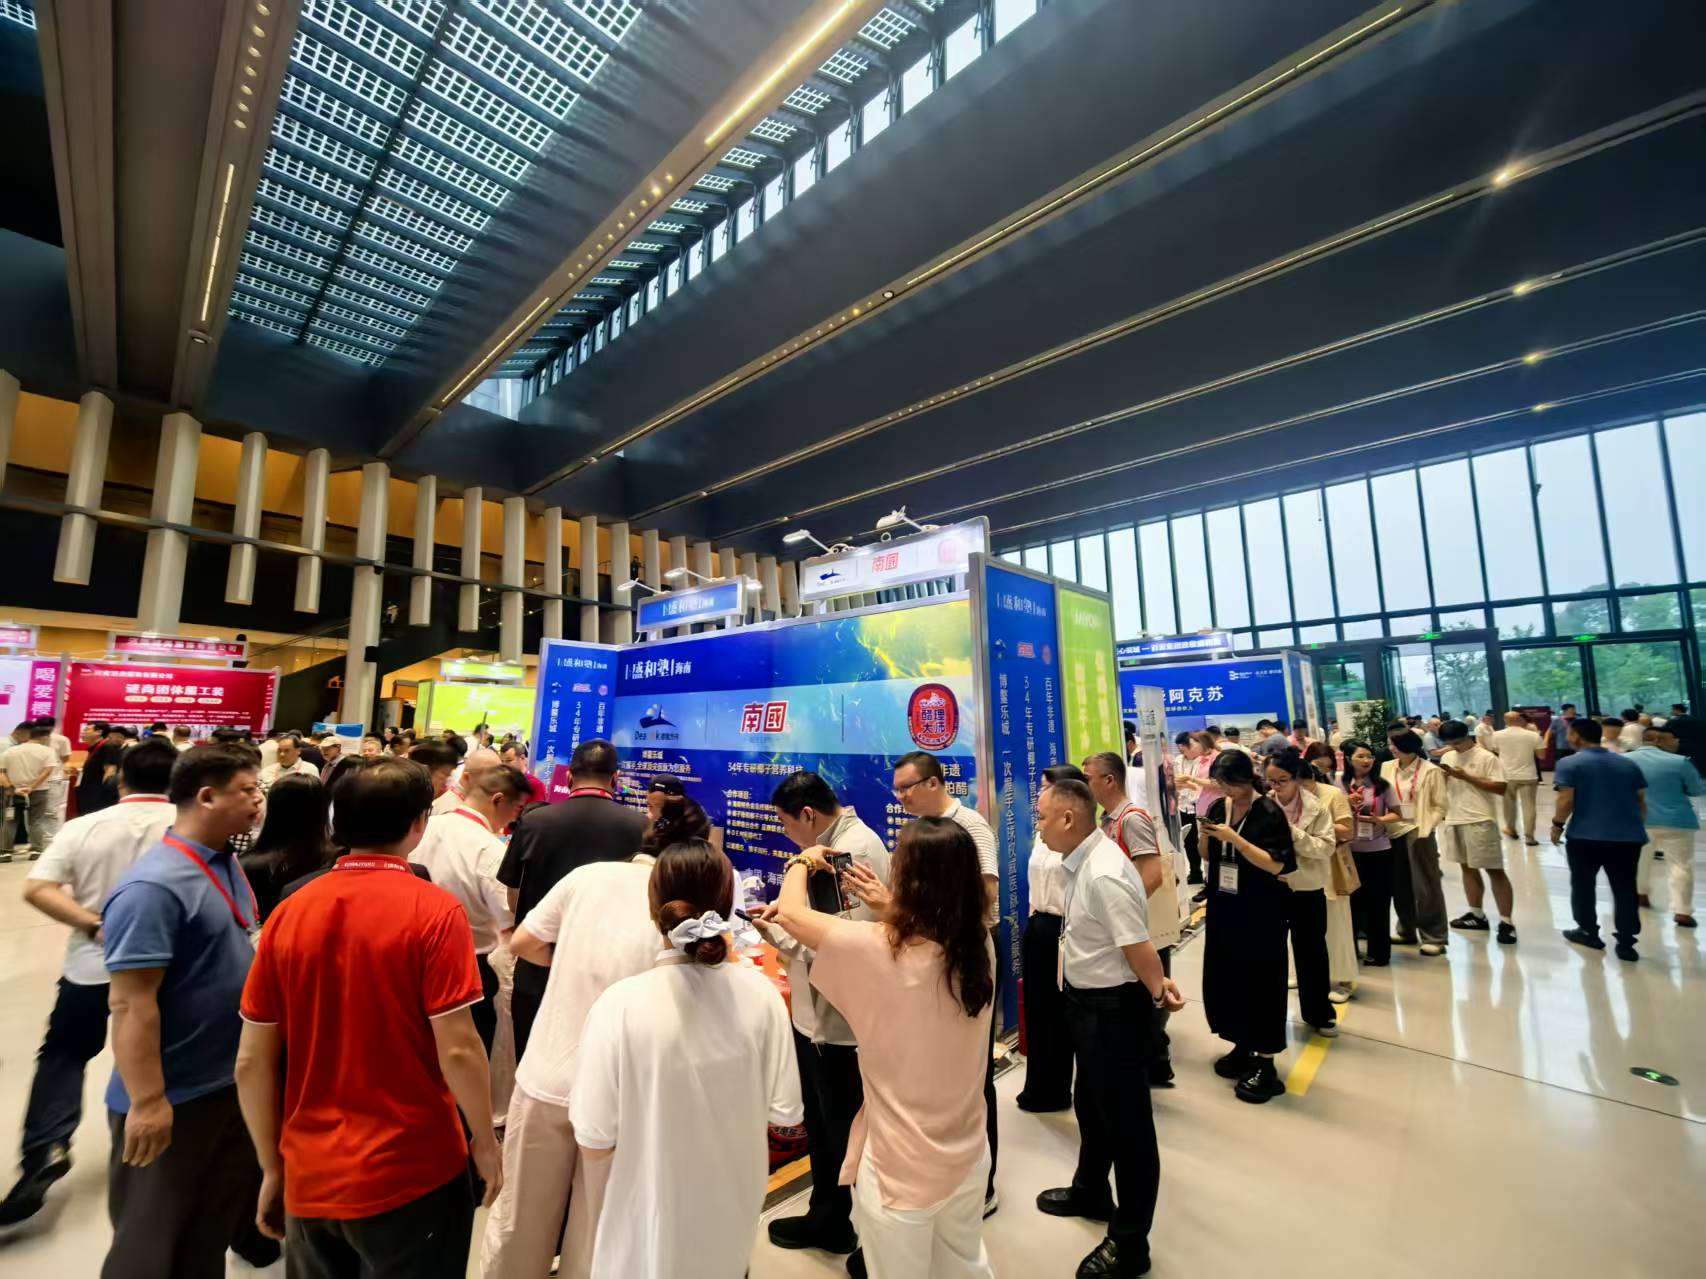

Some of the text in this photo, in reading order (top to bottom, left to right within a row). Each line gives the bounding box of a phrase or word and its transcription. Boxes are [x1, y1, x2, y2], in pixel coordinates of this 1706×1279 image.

[632, 657, 692, 680] 盛和塾 海南
[921, 709, 945, 721] 醋理
[922, 722, 946, 734] 大师
